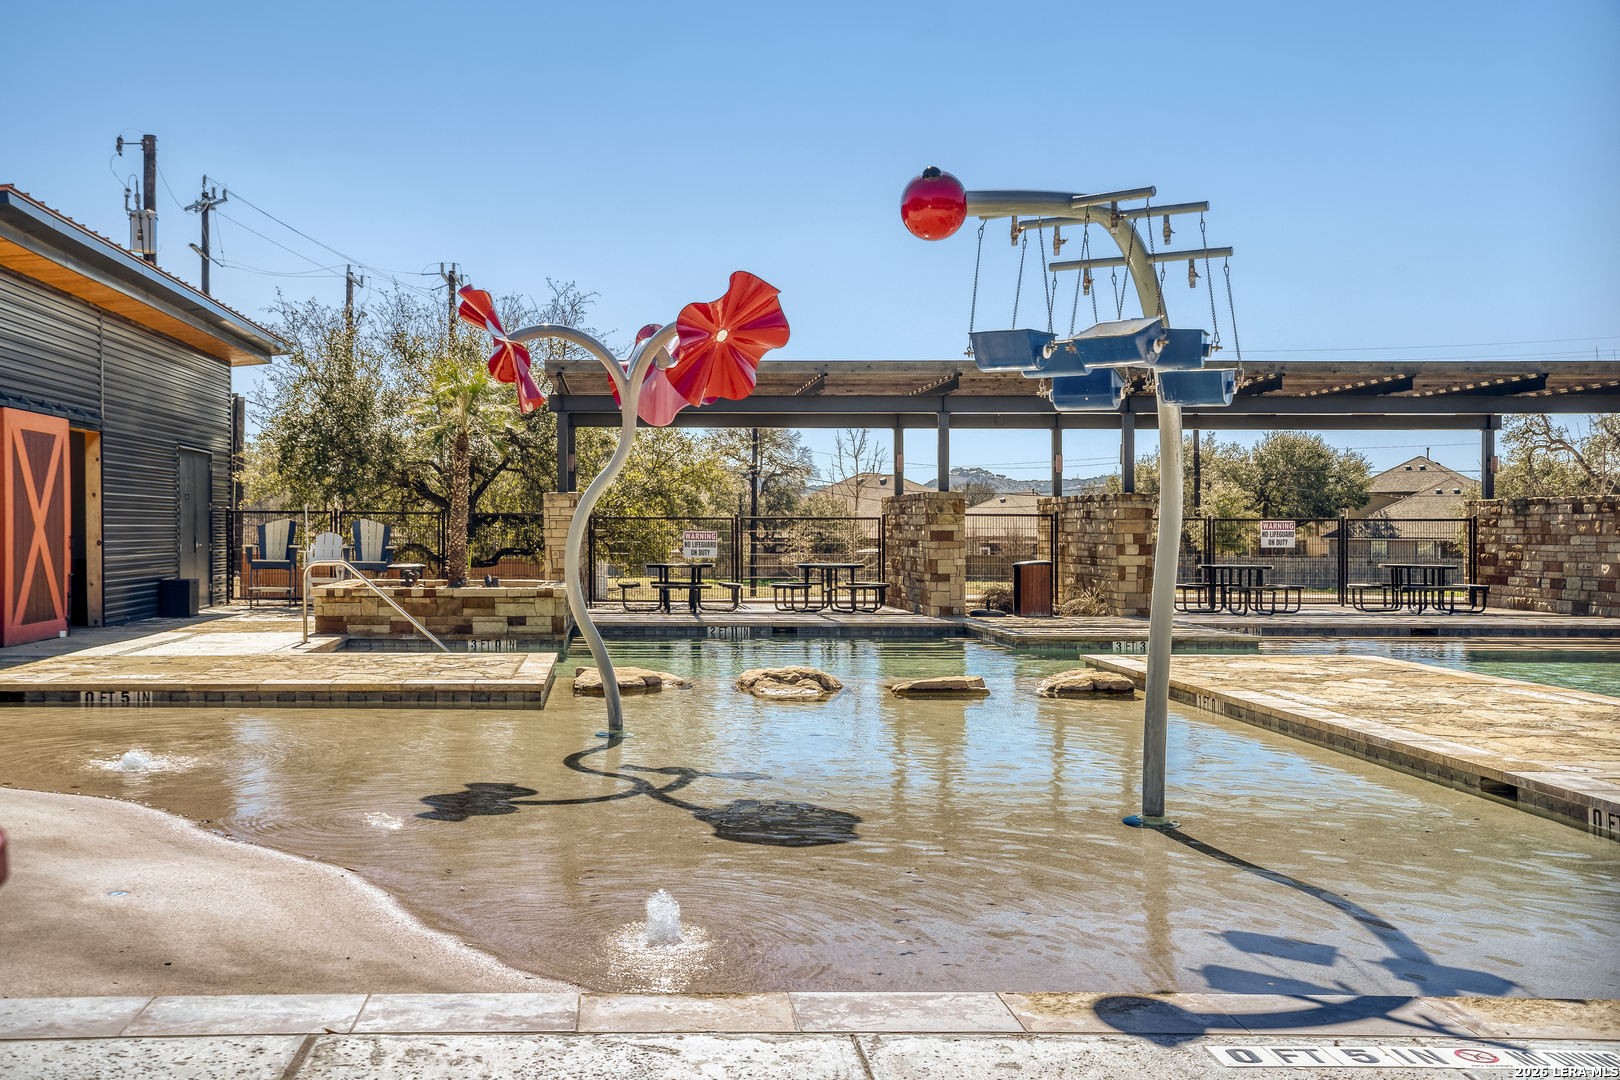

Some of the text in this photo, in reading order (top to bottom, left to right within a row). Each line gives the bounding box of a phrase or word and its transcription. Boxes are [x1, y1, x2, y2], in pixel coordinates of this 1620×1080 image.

[1262, 522, 1294, 530] WARNING
[471, 639, 477, 648] 3
[481, 639, 491, 648] FT
[506, 639, 515, 648] IN
[1115, 641, 1146, 650] 3 FT 3
[100, 691, 115, 702] FT
[121, 691, 130, 702] 5
[137, 691, 151, 702] IN
[1268, 1048, 1325, 1064] FT
[1339, 1048, 1381, 1064] 5
[1389, 1048, 1452, 1065] IN
[1504, 1050, 1551, 1067] NO
